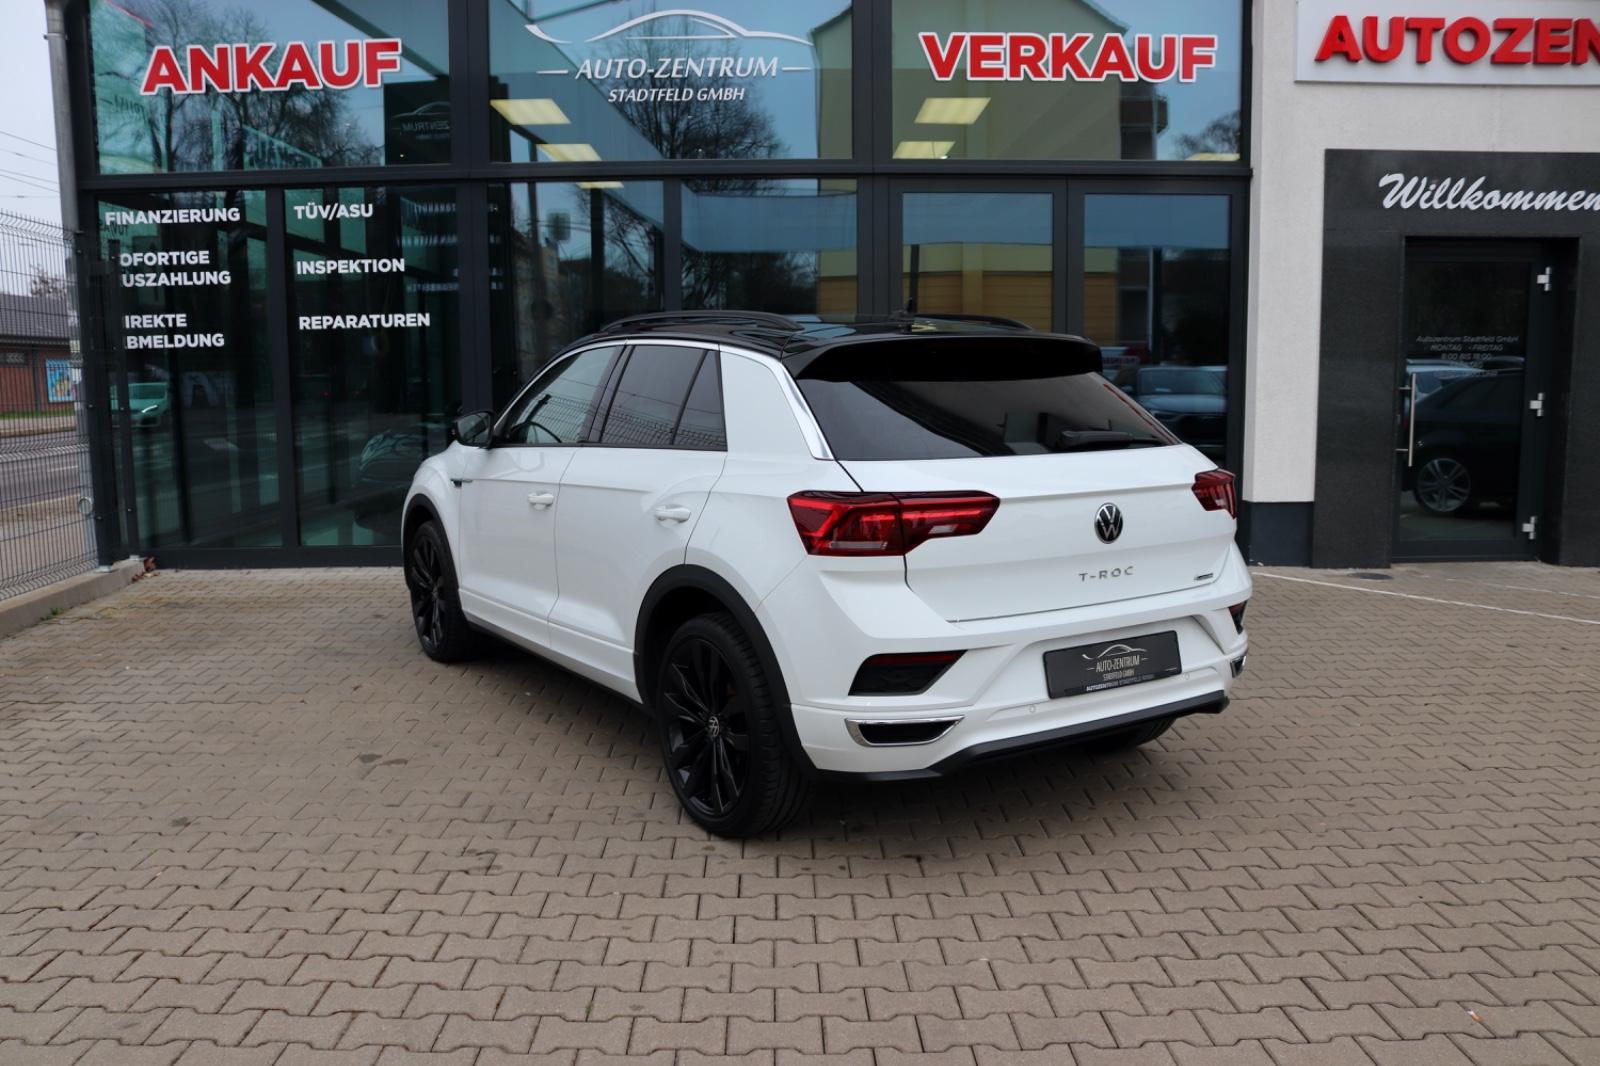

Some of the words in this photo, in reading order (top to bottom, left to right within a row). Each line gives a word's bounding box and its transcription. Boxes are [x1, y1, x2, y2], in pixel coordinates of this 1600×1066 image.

[918, 32, 1218, 83] VERKAUF
[140, 38, 403, 96] ANKAUF
[575, 56, 778, 80] AUTO-ZENTRUM
[608, 87, 693, 103] STADTFELD
[697, 87, 745, 102] GMBH
[1378, 172, 1600, 211] Willkommen
[105, 207, 241, 225] FINANZIERUNG
[293, 202, 374, 220] TÜV/ASU
[119, 250, 210, 267] OFORTIGE
[296, 257, 406, 276] INSPEKTION
[121, 270, 232, 288] USZAHLUNG
[124, 313, 187, 329] IREKTE
[298, 312, 431, 330] REPARATUREN
[126, 333, 225, 349] BMELDUNG
[1078, 565, 1134, 582] T-ROC
